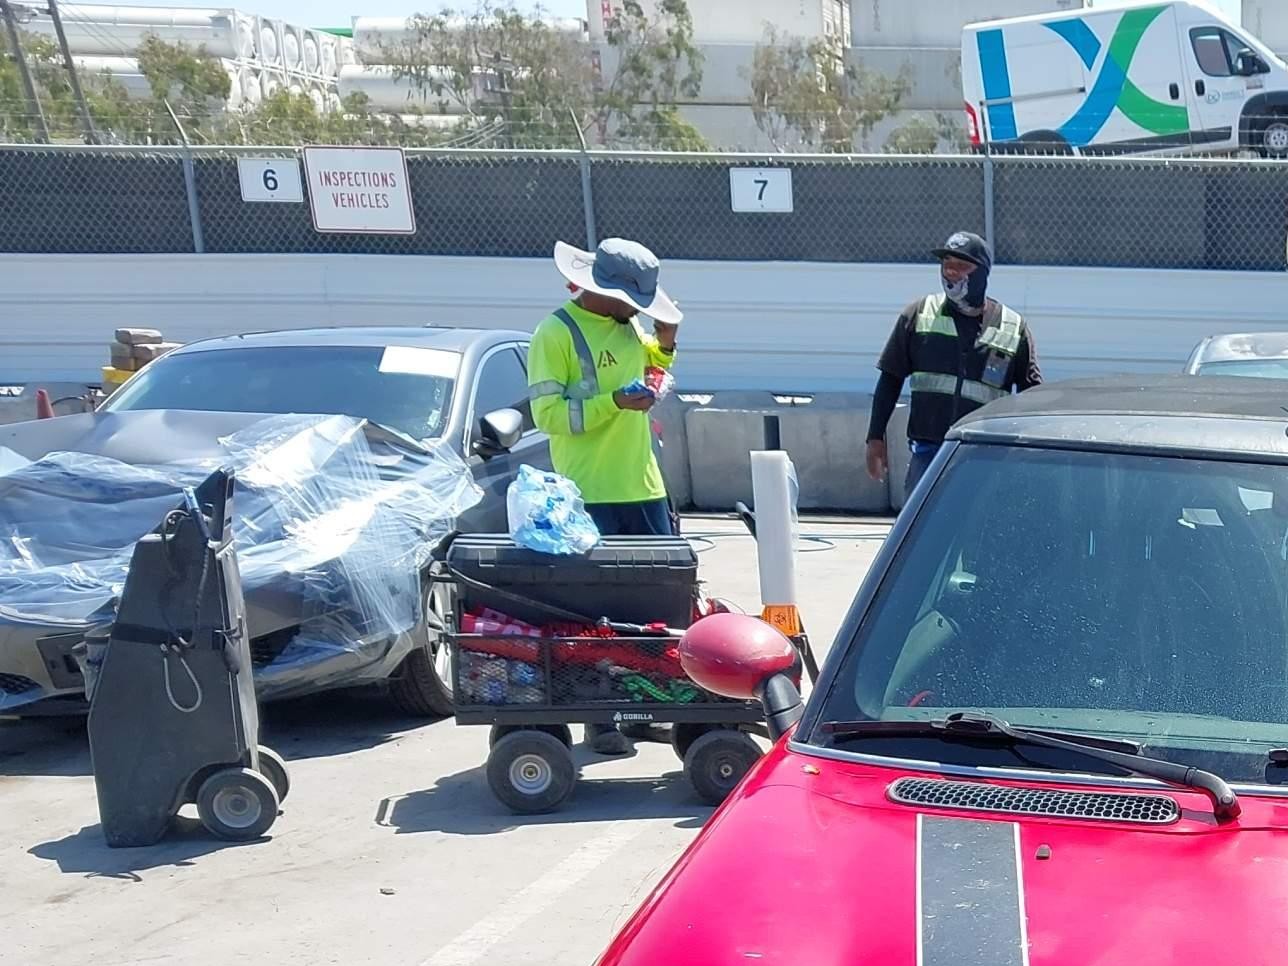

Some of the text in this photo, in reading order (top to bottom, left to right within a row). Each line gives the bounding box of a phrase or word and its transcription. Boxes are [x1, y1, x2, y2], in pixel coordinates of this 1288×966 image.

[262, 168, 279, 191] 6
[319, 171, 397, 188] INSPECTIONS
[753, 179, 769, 201] 7
[332, 193, 390, 208] VEHICLES
[622, 713, 654, 721] GORILLA
